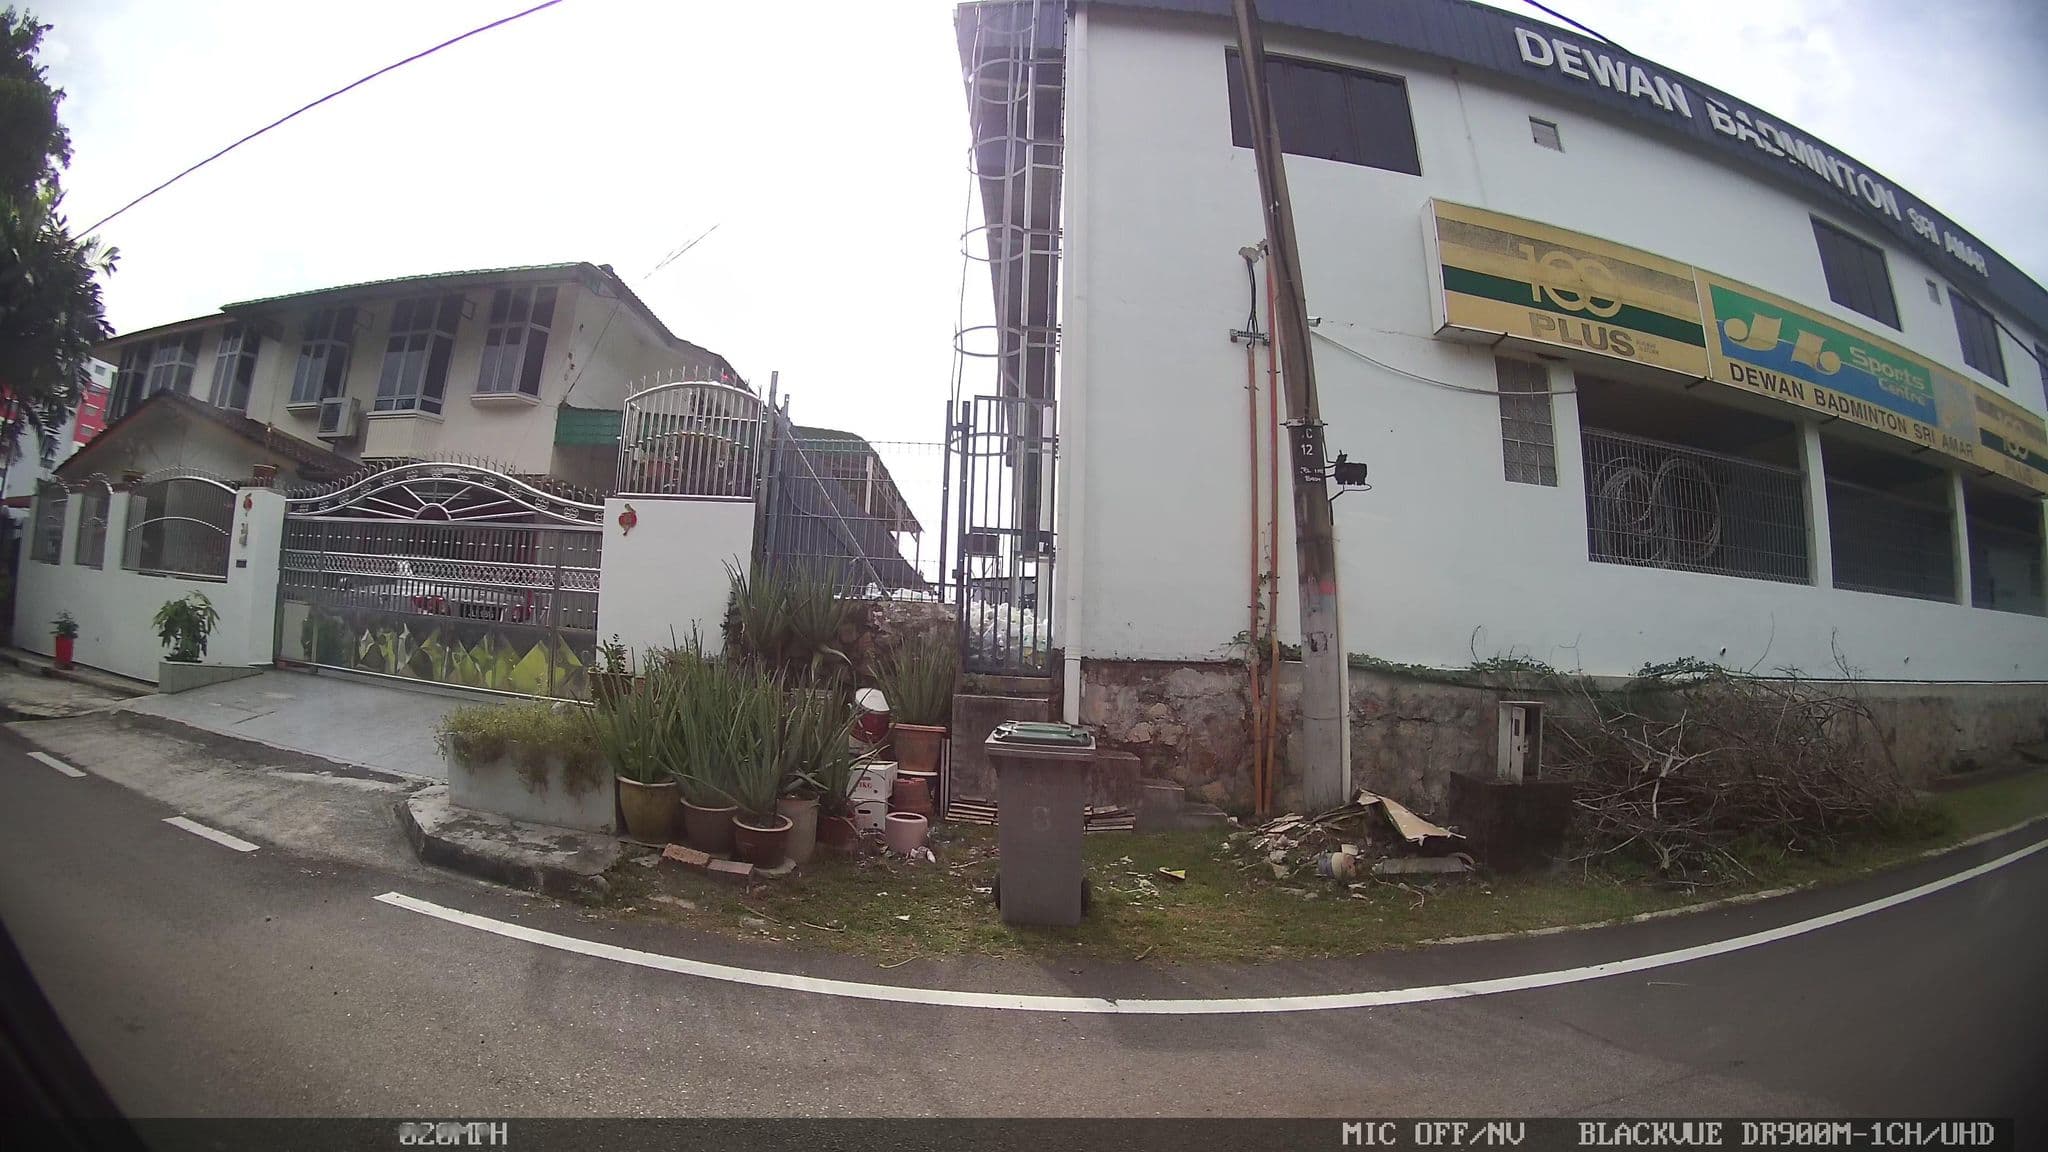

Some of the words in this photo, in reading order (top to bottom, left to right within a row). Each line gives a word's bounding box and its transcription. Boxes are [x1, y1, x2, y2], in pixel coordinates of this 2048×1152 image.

[1514, 26, 1693, 119] DEWAN
[1705, 96, 1902, 221] BADMINTON
[1906, 207, 1940, 245] SRI
[1519, 242, 1625, 318] 100
[1528, 311, 1636, 357] PLUS
[1849, 345, 1926, 390] Sports
[1729, 362, 1805, 401] DEWAN
[1813, 388, 1908, 435] BADMINTON
[1914, 423, 1937, 445] SRI
[1941, 432, 1974, 458] AMAR
[1301, 443, 1314, 456] 12
